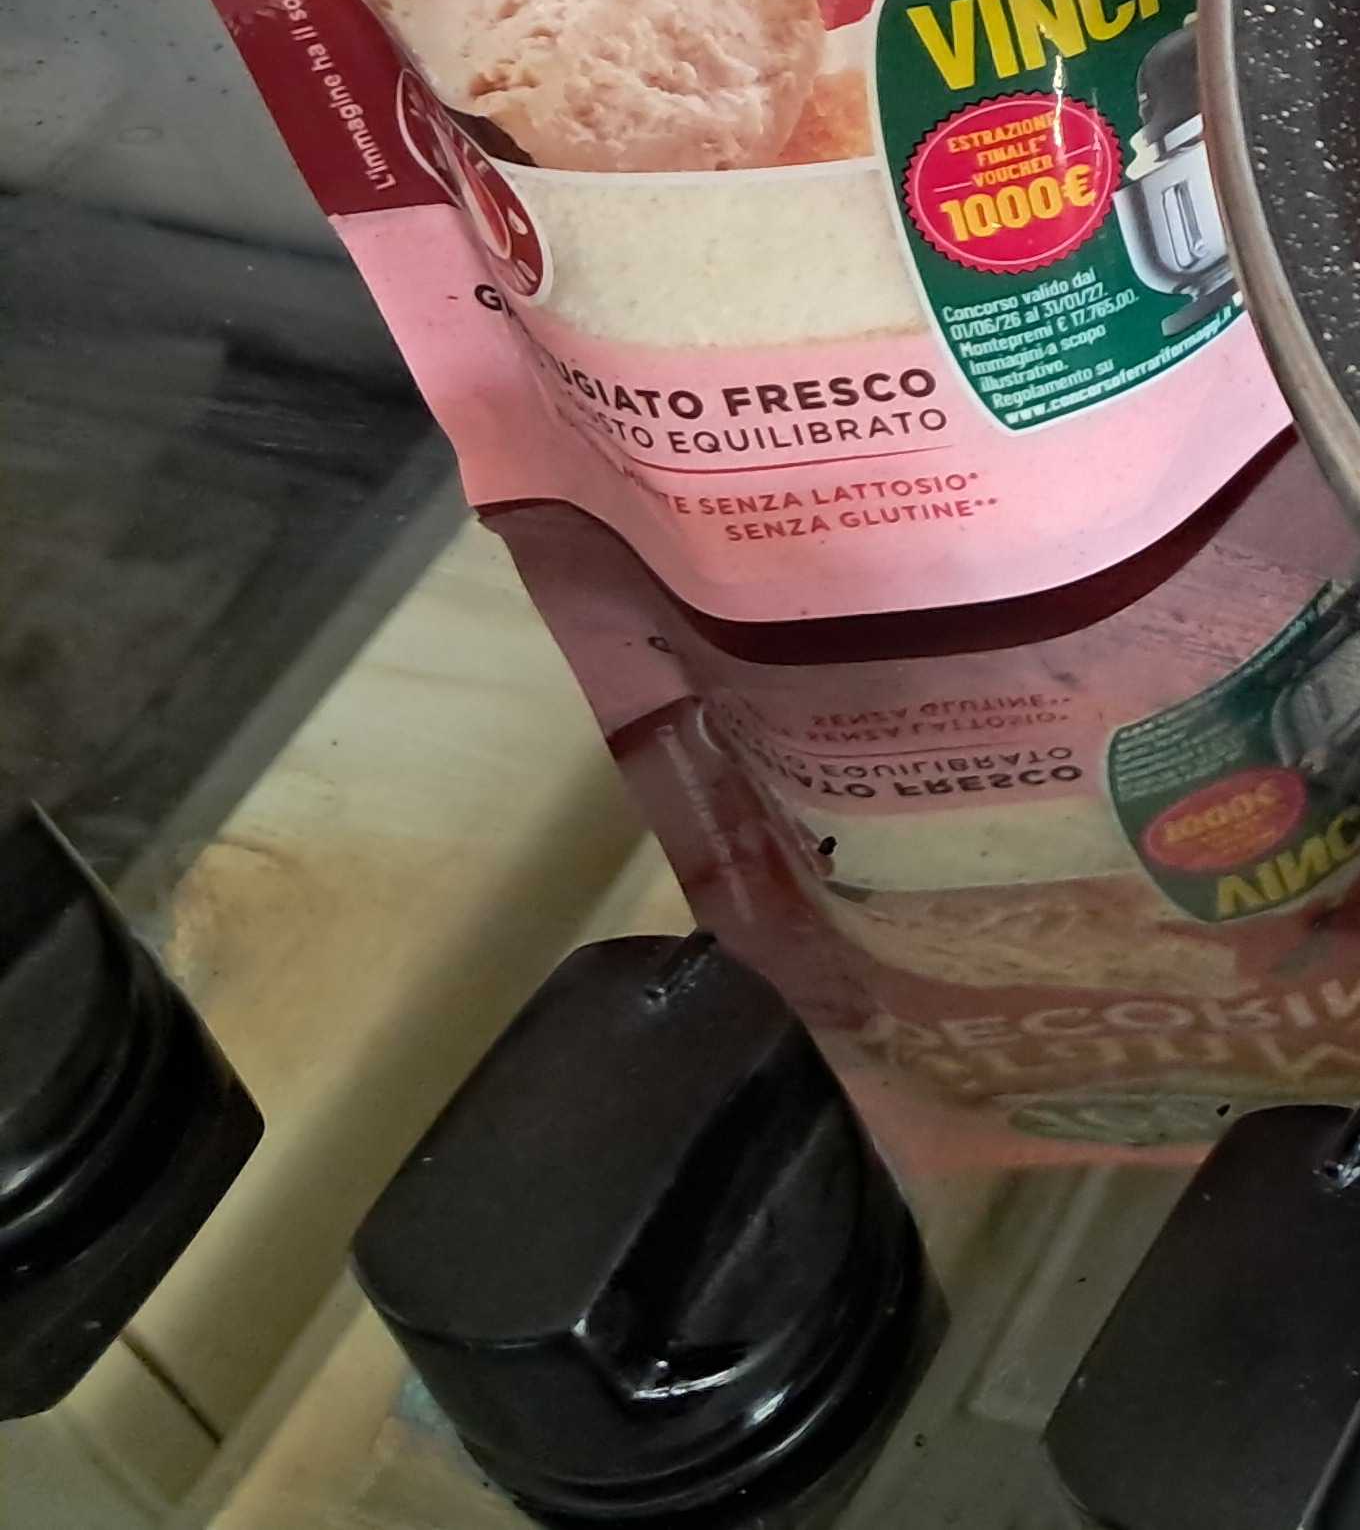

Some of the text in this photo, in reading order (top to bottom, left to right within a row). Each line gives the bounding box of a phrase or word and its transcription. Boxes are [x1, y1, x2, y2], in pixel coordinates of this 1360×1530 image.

[291, 26, 318, 41] il
[308, 43, 333, 71] ha
[972, 155, 1054, 187] VOUCHER
[940, 164, 1097, 242] 1000€
[942, 267, 1096, 323] Concorso valido dal
[1024, 306, 1040, 323] al
[960, 322, 1053, 359] Montepremi
[1057, 316, 1069, 332] €
[969, 342, 1043, 375] Immagini
[1060, 325, 1106, 351] scopo
[722, 368, 937, 418] FRESCO
[992, 359, 1114, 408] Regolamento su
[668, 408, 947, 454] EQUILIBRATO
[699, 491, 801, 517] SENZA
[725, 514, 830, 542] SENZA
